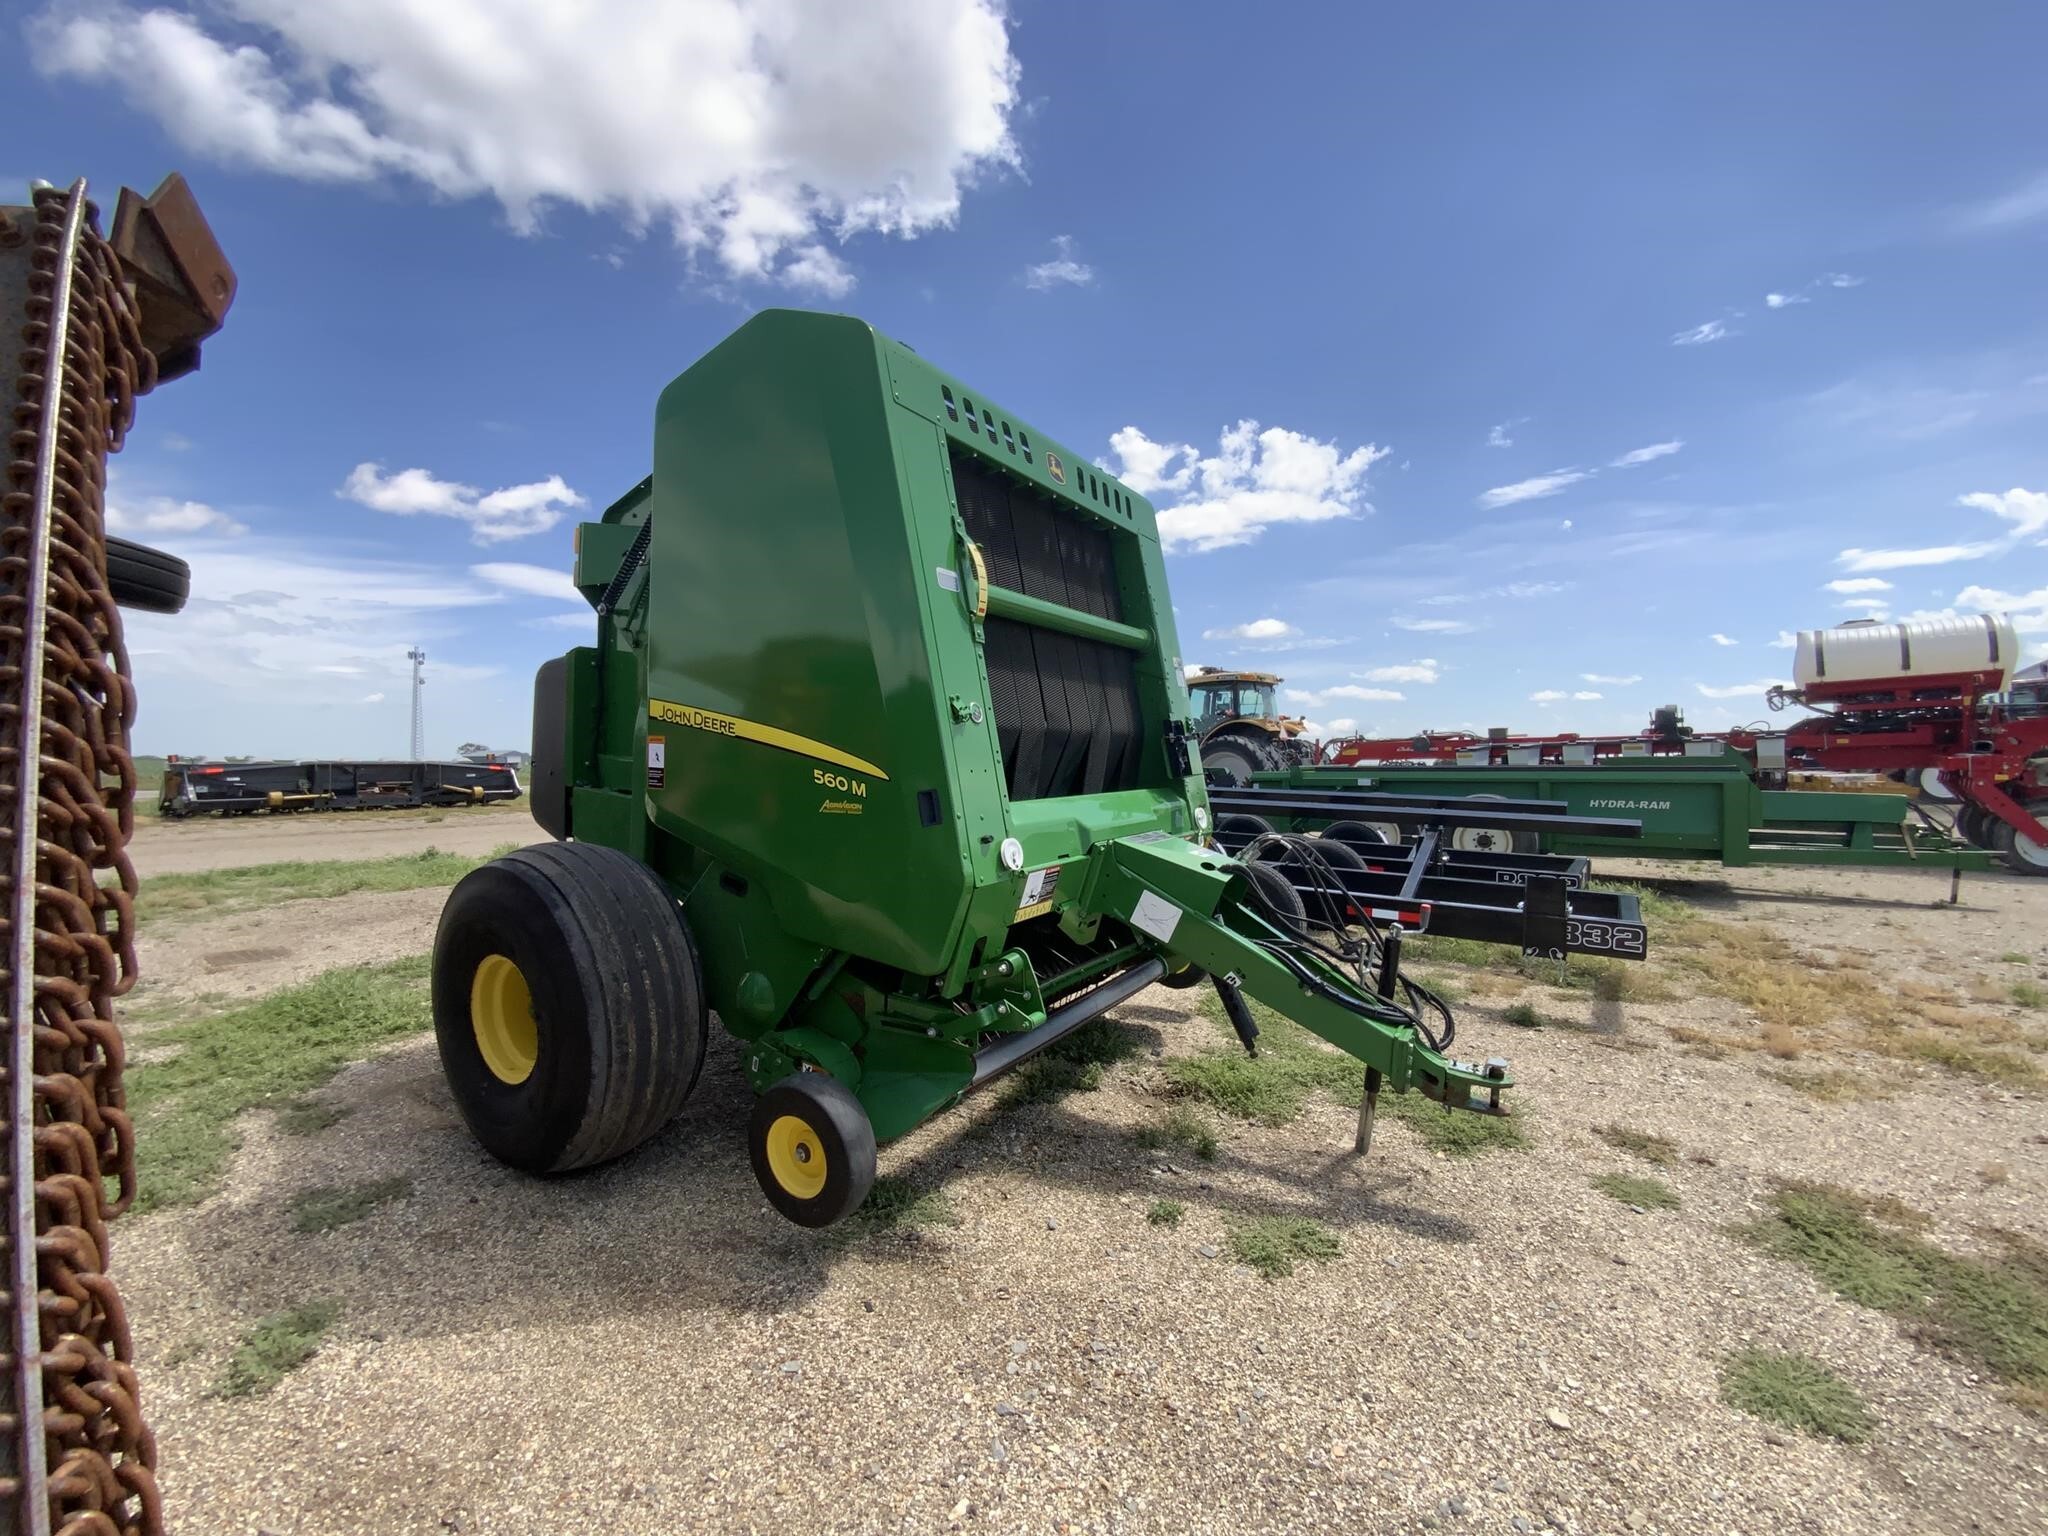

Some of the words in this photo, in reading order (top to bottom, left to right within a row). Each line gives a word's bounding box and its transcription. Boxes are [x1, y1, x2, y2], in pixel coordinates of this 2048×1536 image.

[659, 705, 691, 725] JOHN
[694, 711, 736, 735] DEERE
[813, 768, 849, 791] 560
[851, 780, 866, 798] M
[1589, 799, 1671, 810] HYDRA-RAM
